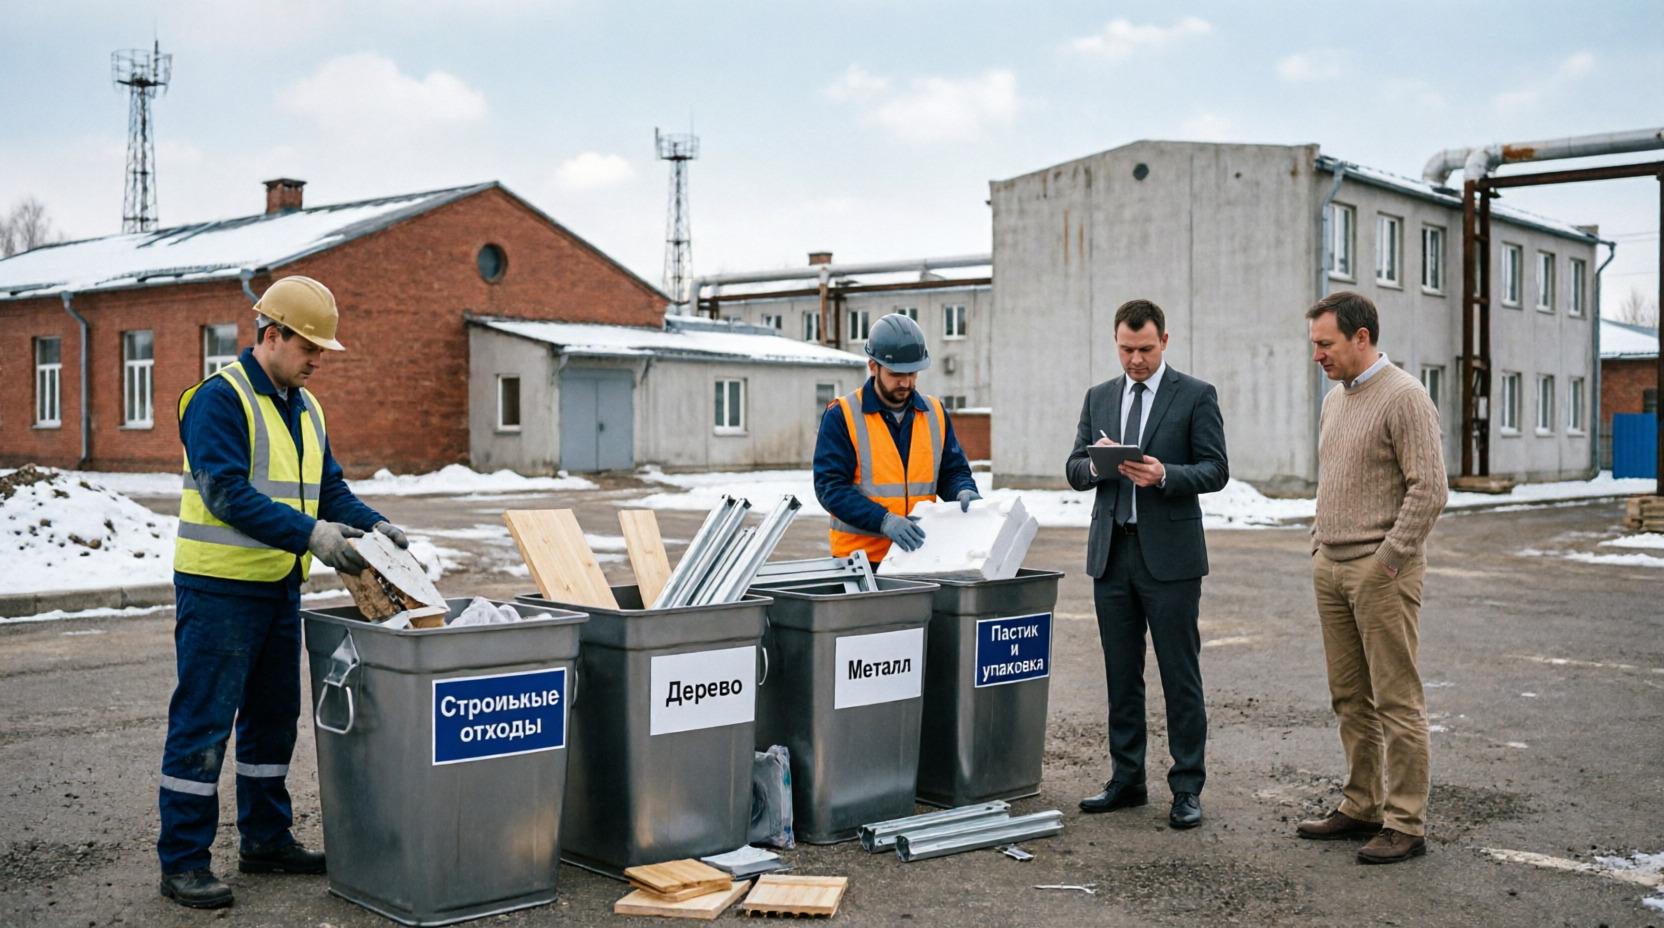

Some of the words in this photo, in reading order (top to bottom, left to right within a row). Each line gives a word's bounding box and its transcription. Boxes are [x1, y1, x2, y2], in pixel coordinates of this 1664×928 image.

[991, 624, 1038, 642] Пастик
[1010, 643, 1019, 656] и
[848, 658, 912, 680] Металл
[983, 658, 1044, 682] упаковка
[665, 681, 743, 708] Дерево
[460, 719, 543, 743] отходы
